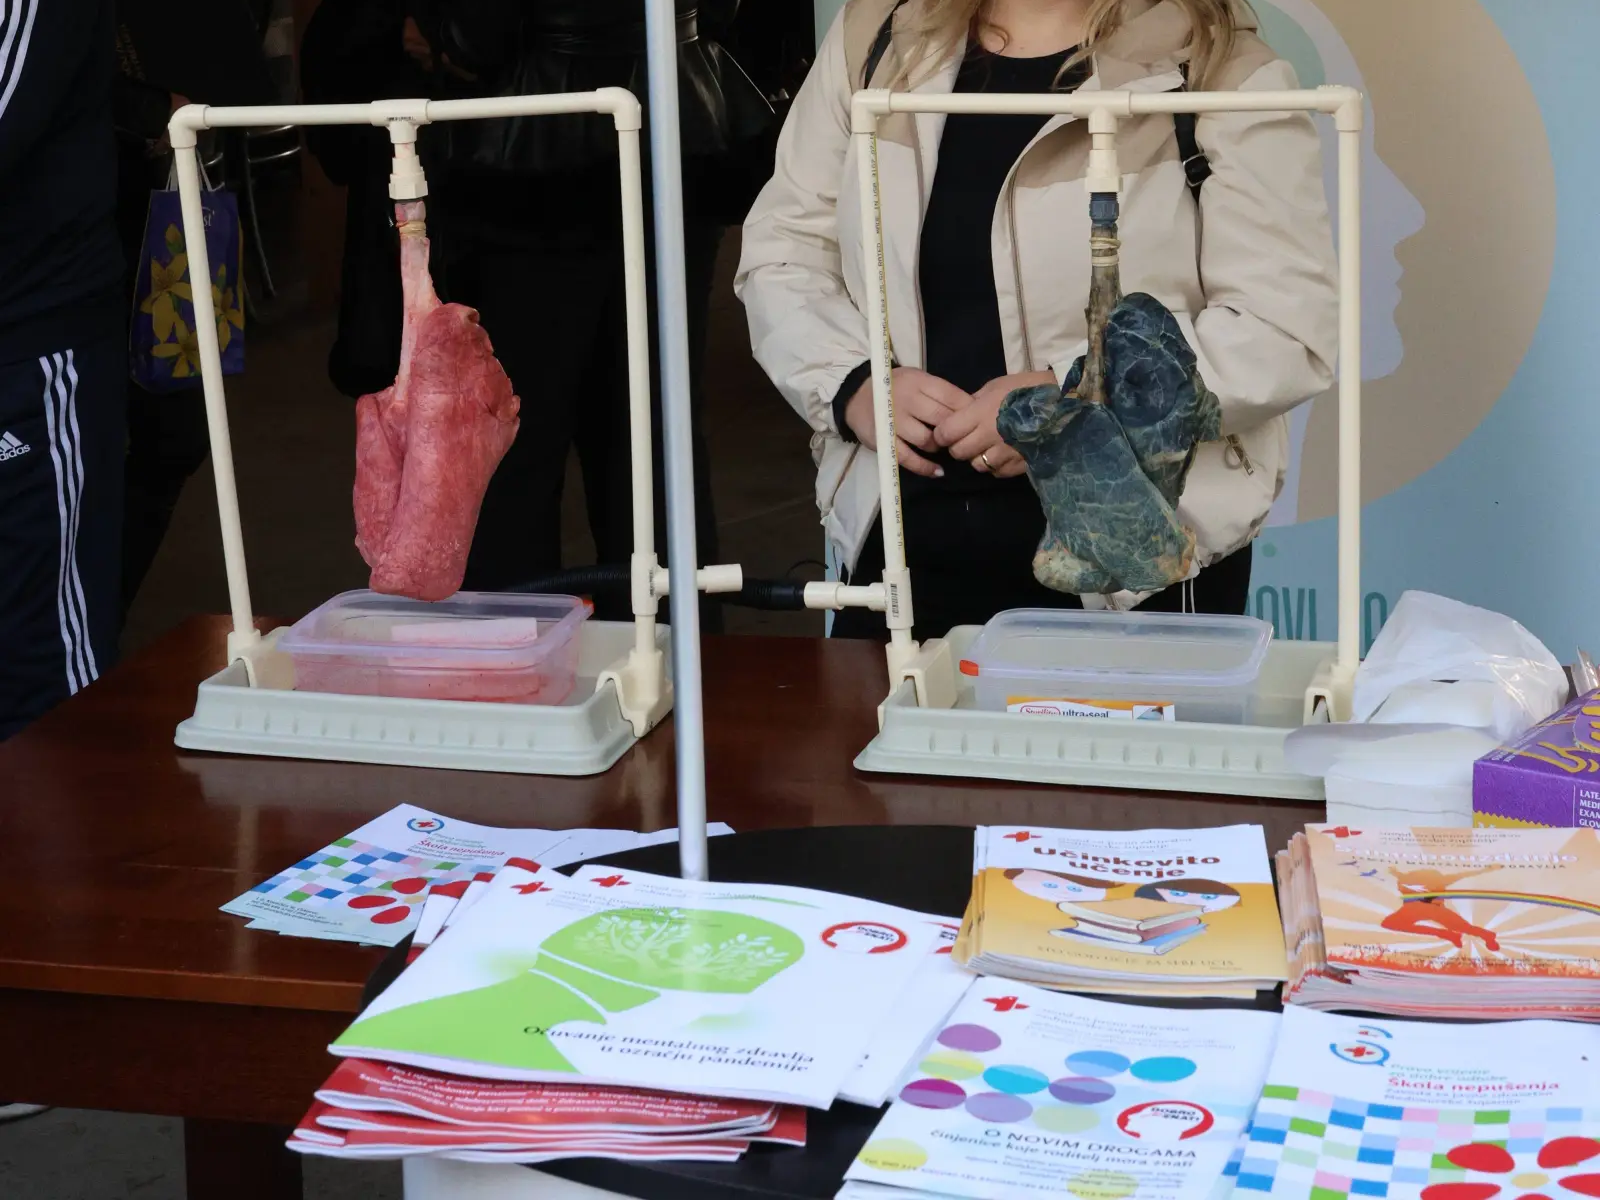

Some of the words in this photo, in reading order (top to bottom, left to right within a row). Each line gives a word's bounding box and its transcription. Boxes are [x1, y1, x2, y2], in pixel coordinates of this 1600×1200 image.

[0, 443, 31, 462] didas
[1068, 860, 1186, 879] učenje
[984, 1128, 1001, 1139] O
[1006, 1132, 1082, 1150] NOVIM
[1087, 1142, 1198, 1158] DROGAMA
